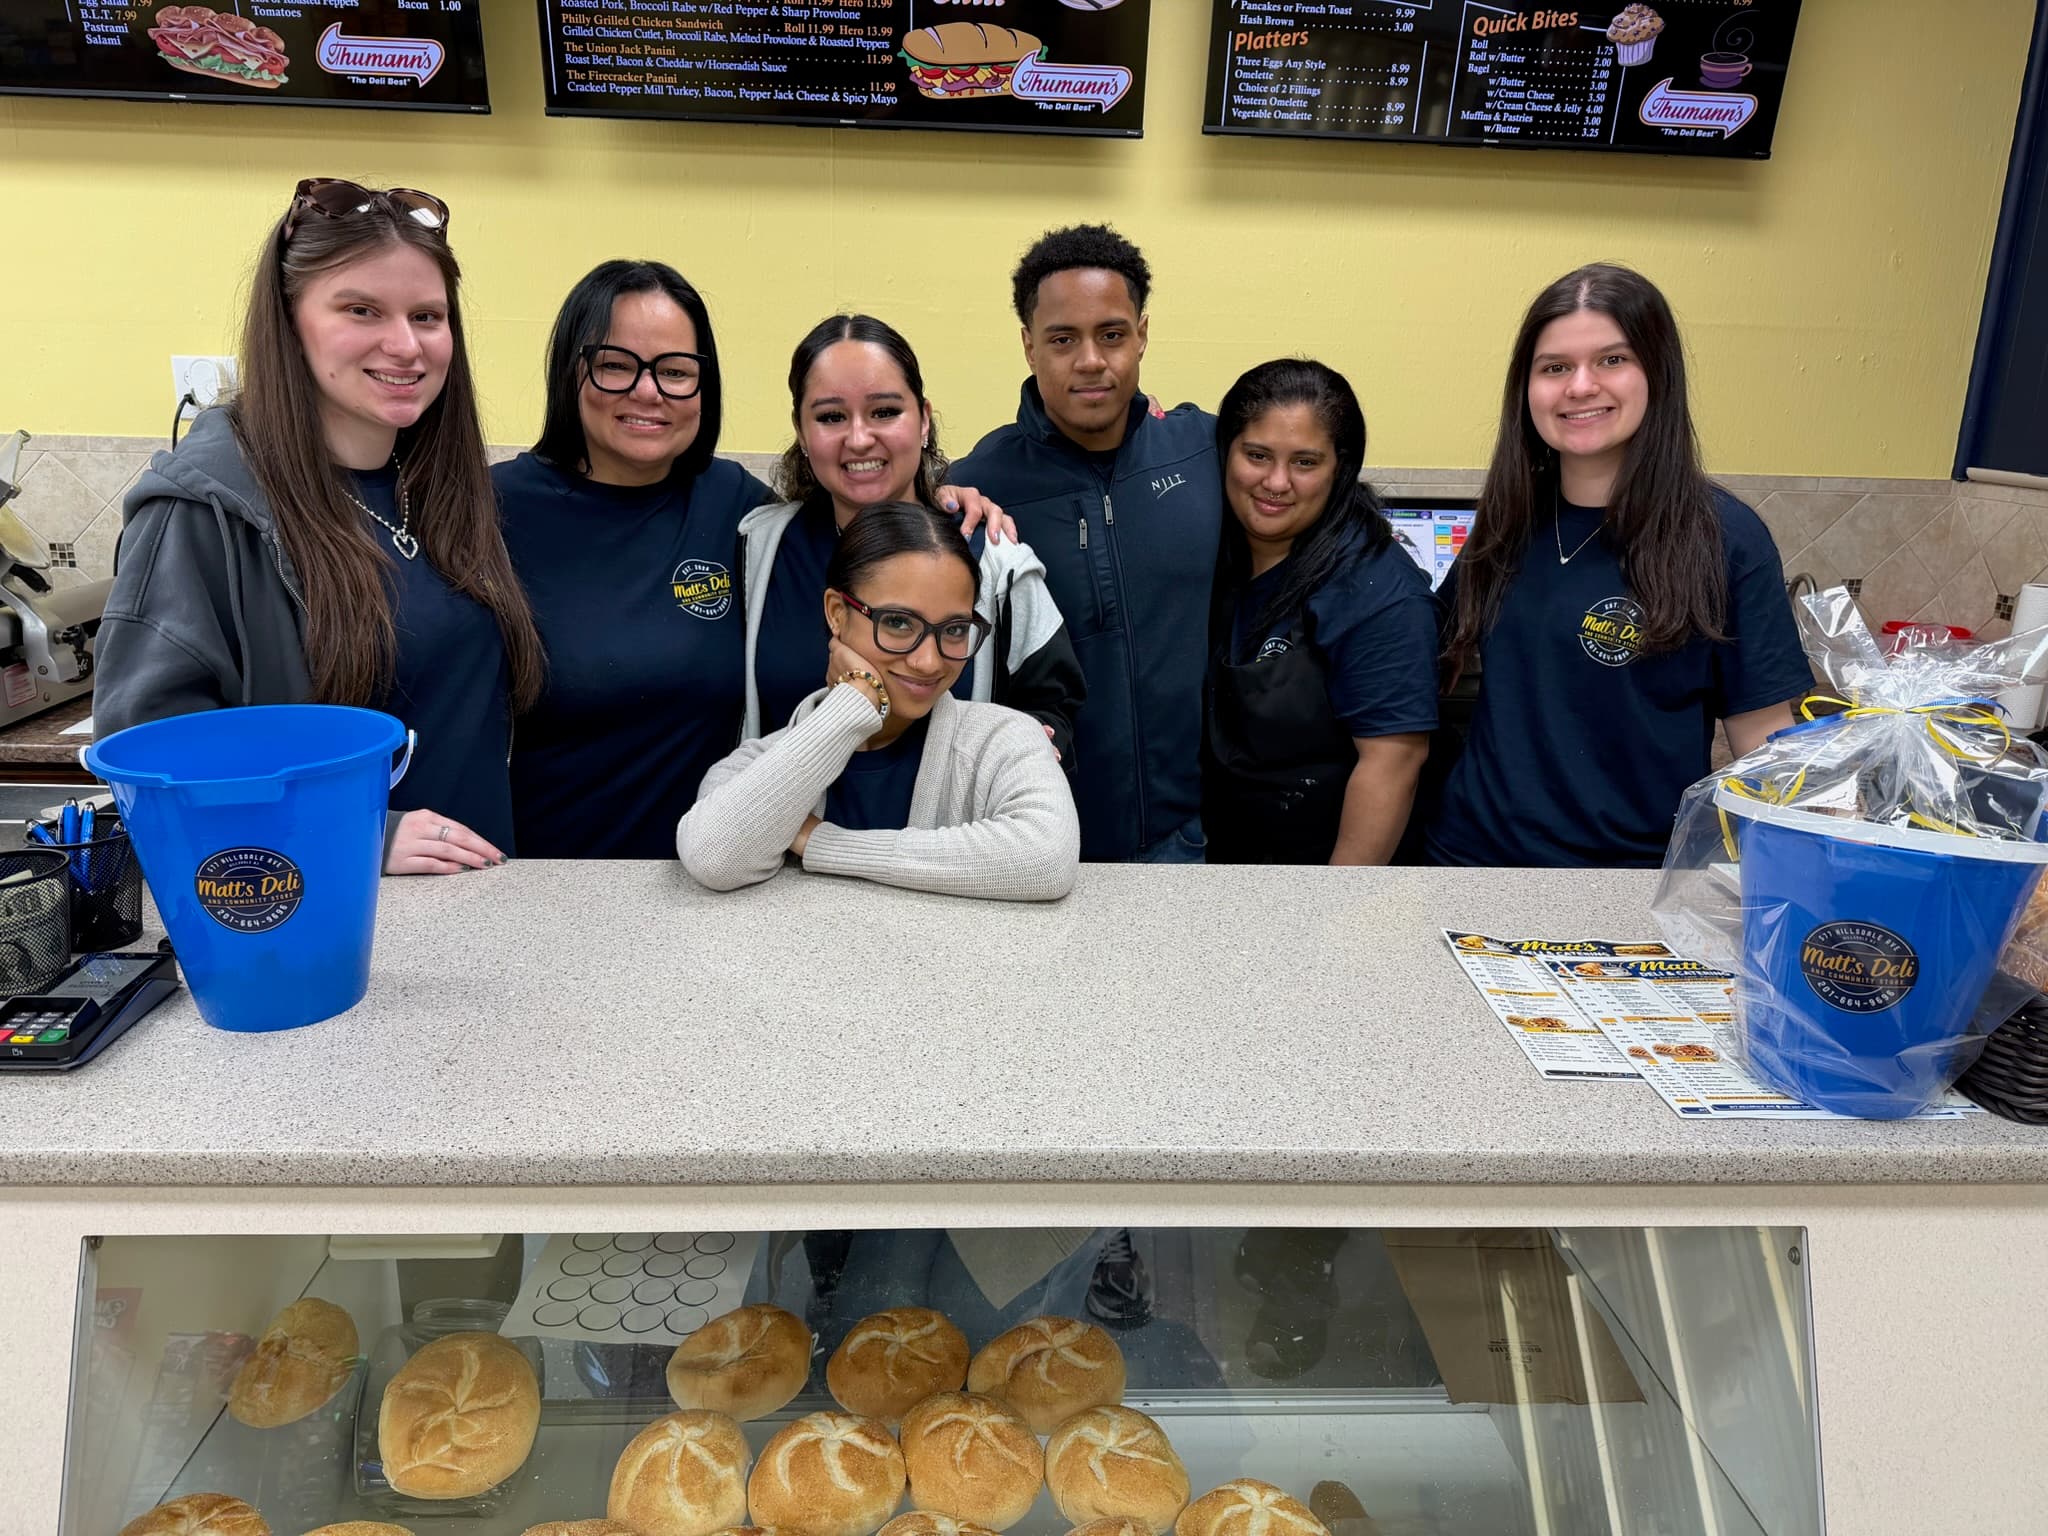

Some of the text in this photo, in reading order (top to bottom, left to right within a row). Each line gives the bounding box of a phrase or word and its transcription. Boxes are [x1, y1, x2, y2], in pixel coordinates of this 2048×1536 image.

[251, 6, 302, 17] Tomatoes
[398, 0, 461, 11] Bacon 1.00
[602, 0, 627, 11] Pork,
[630, 1, 670, 11] Broccoli
[672, 2, 697, 13] Rabe
[700, 3, 733, 14] w/Red
[735, 4, 768, 18] Pepper
[770, 6, 780, 16] &
[782, 6, 810, 20] Sharp
[813, 8, 861, 20] Provolone
[1240, 0, 1416, 18] Pancakes or French Toast 9.99
[80, 9, 137, 20] B.L.T. 7.99
[1473, 9, 1579, 37] Quick Bites
[82, 22, 129, 33] Pastrami
[562, 14, 893, 37] Philly Grilled Chicken Sandwich Roll 11.99 Hero 13.99
[1240, 15, 1414, 32] Hash Brown 3.00
[85, 34, 122, 45] Salami
[563, 26, 890, 51] Grilled Chicken Cutlet, Broccoli Rabe, Melted Provolone & Roasted Peppers
[1234, 31, 1309, 52] Platters
[1471, 39, 1614, 55] Roll 1.75
[326, 42, 431, 70] Thumann's
[564, 42, 893, 64] The Union Jack Panini 11.99
[1469, 51, 1612, 67] Roll w/Butter 2.00
[565, 54, 787, 72] Roast Beef, Bacon & Cheddar w/Horseradish Sauce
[1236, 56, 1410, 73] Three Eggs Any Style 8.99
[1468, 64, 1610, 79] Bagel 2.00
[369, 77, 385, 85] Deli
[566, 69, 896, 92] The Firecracker Panini 11.99
[1019, 69, 1118, 96] Thumann's
[1235, 69, 1409, 86] Omelette 8.99
[1489, 77, 1608, 91] w/Butter 3.00
[568, 82, 898, 106] Cracked Pepper Mill Turkey, Bacon, Pepper Jack Cheese & Spicy Mayo
[1239, 82, 1321, 97] Choice of 2 Fillings
[1487, 88, 1605, 102] w/Cream Cheese 3.50
[1055, 103, 1072, 111] Deli
[1233, 95, 1405, 112] Western Omelette 8.99
[1485, 101, 1603, 115] w/Cream Cheese & Jelly 4.00
[1648, 96, 1745, 122] Thumann's
[1232, 108, 1404, 124] Vegetable Omelette 8.99
[1460, 110, 1601, 126] Muffins & Pastries 3.00
[1484, 124, 1599, 137] w/Butter 3.25
[674, 583, 708, 599] Matt's
[710, 574, 731, 591] Deli
[1582, 615, 1617, 636] Matt's
[221, 854, 264, 864] HILLSDALE
[268, 858, 283, 868] AVE
[199, 872, 300, 898] Matt's Deli
[217, 904, 288, 928] 201-664-9696
[1512, 940, 1598, 952] Matt's
[1835, 928, 1883, 941] HILLSDALE
[1885, 940, 1901, 952] AVE
[1803, 945, 1915, 978] Matt's Deli
[1829, 972, 1874, 984] COMMUNITY
[1818, 981, 1895, 1008] 201-664-9696
